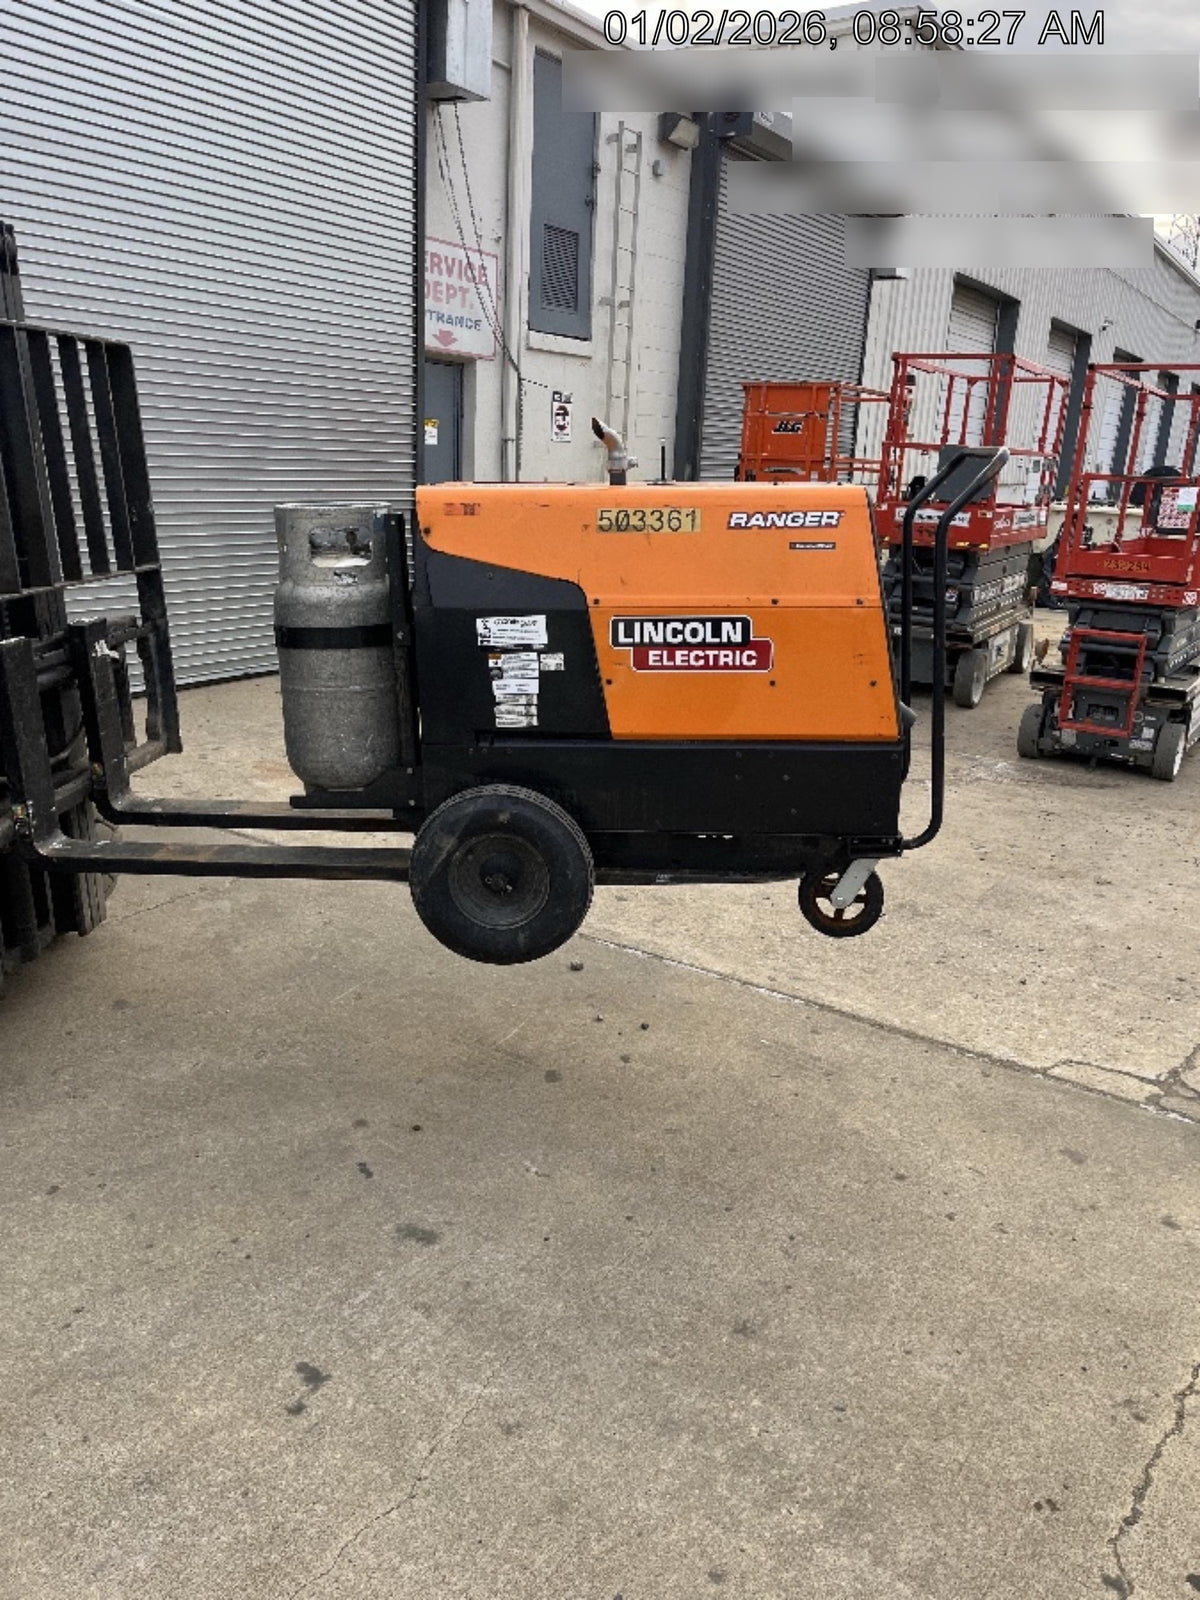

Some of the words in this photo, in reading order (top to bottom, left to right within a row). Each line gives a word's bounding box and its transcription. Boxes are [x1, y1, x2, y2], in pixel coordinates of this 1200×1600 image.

[598, 508, 697, 532] 503361
[728, 510, 841, 528] RANGER
[617, 621, 743, 644] LINCOLN
[648, 649, 758, 666] ELECTRIC
